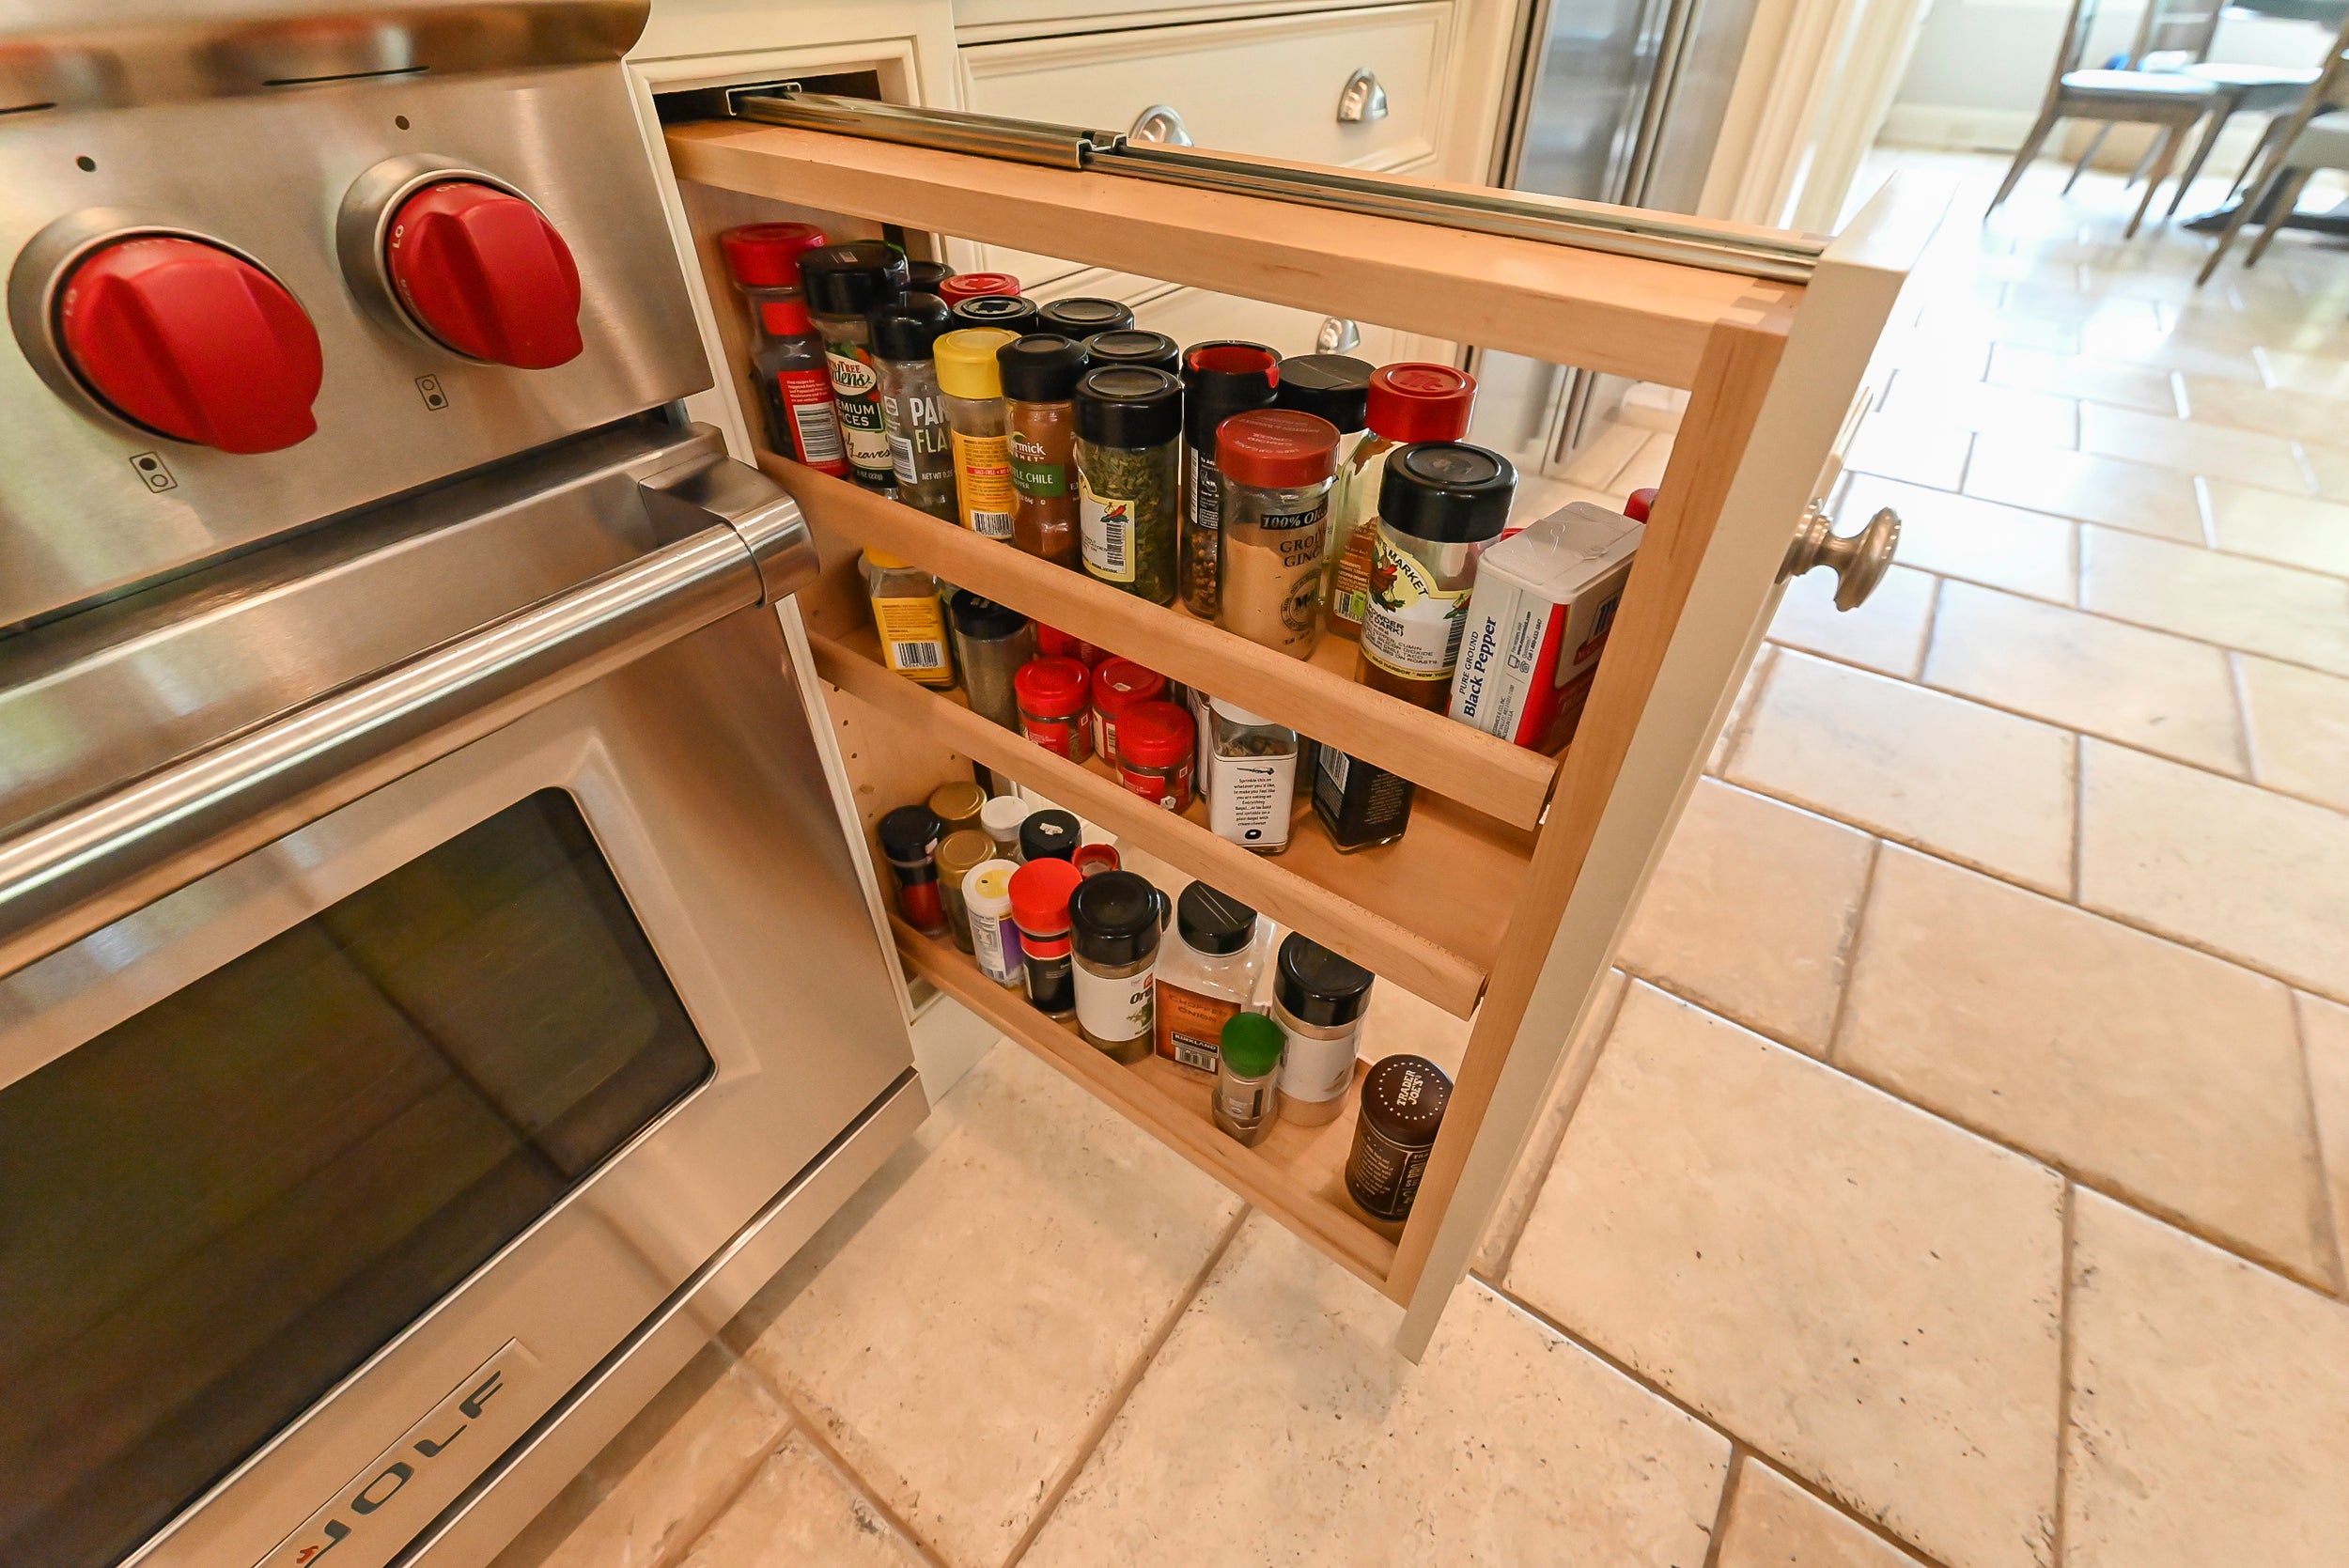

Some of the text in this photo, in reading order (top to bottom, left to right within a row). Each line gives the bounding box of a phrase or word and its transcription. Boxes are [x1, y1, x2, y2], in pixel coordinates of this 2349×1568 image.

[392, 225, 405, 249] LO
[839, 361, 861, 374] TREE
[842, 412, 870, 427] ICES
[915, 427, 948, 453] FLA
[849, 447, 891, 459] Leaves
[933, 472, 941, 480] WT
[1026, 473, 1053, 484] CHILE
[1263, 516, 1300, 527] 100%
[1283, 547, 1323, 567] GING
[1388, 550, 1428, 597] MARKET
[1374, 617, 1404, 637] DARK)
[1398, 642, 1423, 651] CUMIN
[1403, 647, 1434, 657] DIOXIDE
[1383, 661, 1411, 675] HARBOR
[1458, 630, 1479, 695] PURE GROUND
[1463, 615, 1497, 718] Black Pepper
[1129, 986, 1154, 1004] Ore
[1168, 994, 1227, 1017] CHOPPED
[1177, 1006, 1217, 1023] ONION
[1174, 1033, 1218, 1050] KIRKLAND
[1396, 1069, 1417, 1107] TRADER
